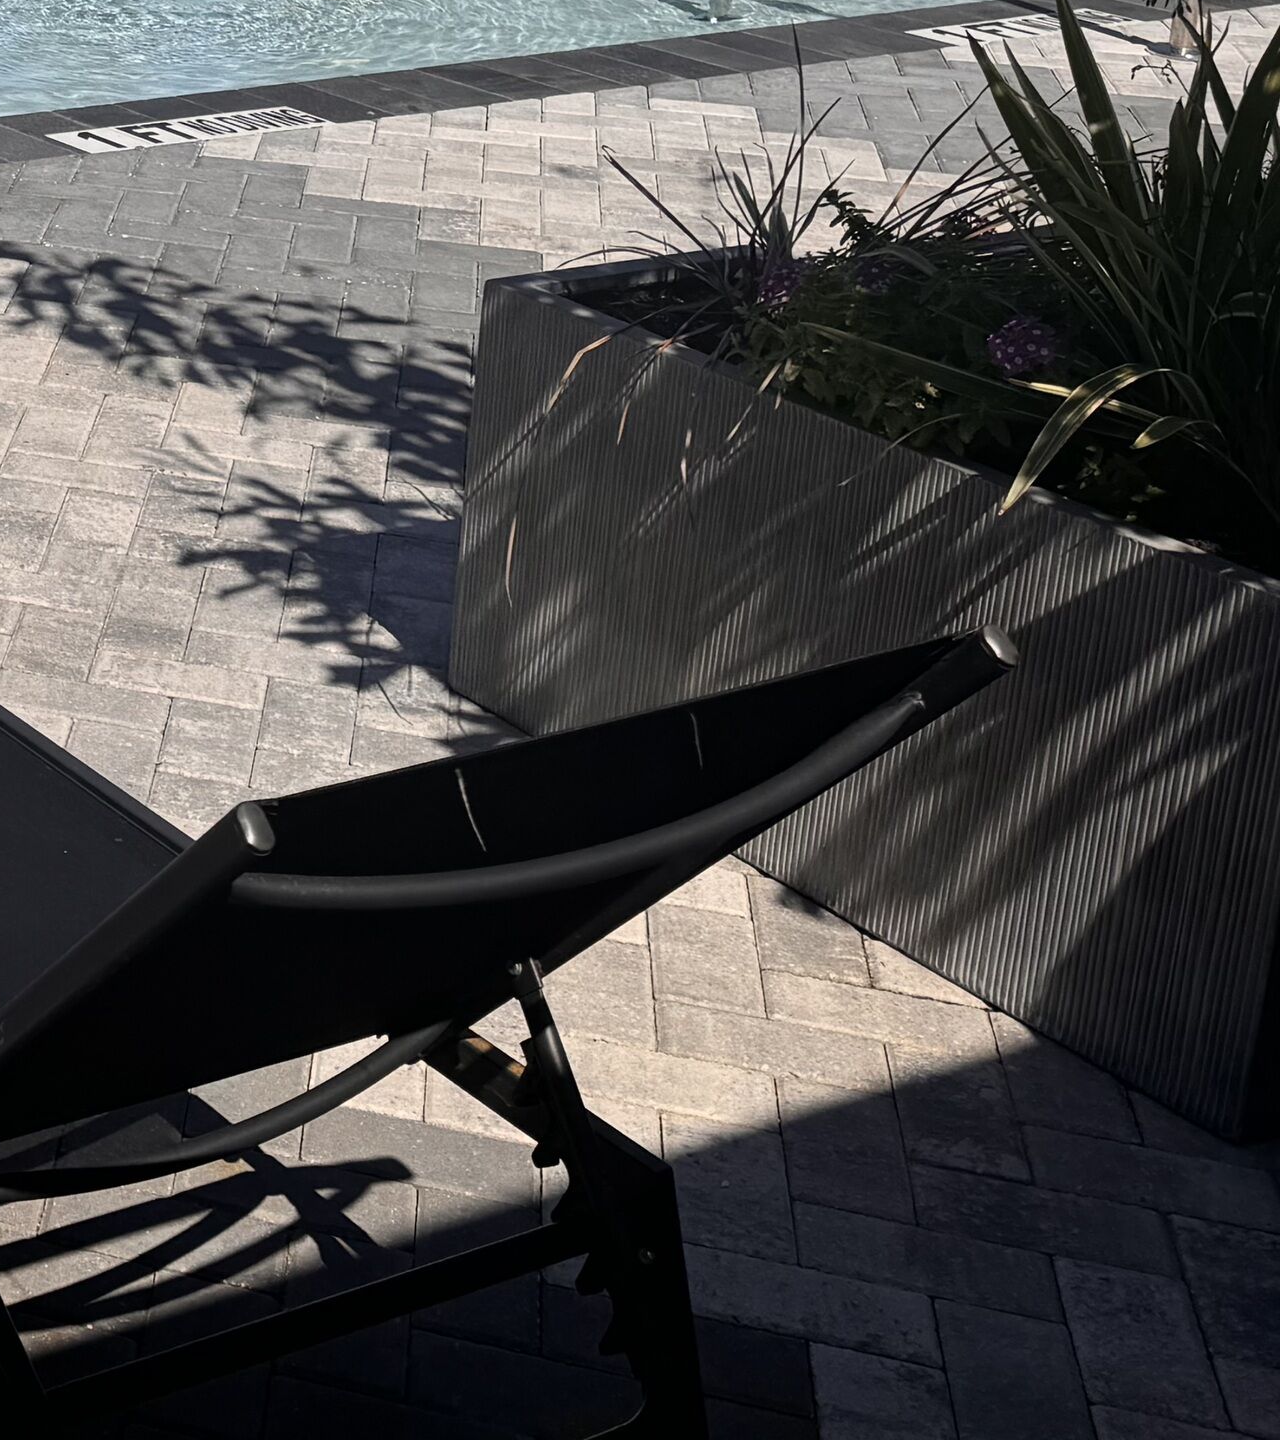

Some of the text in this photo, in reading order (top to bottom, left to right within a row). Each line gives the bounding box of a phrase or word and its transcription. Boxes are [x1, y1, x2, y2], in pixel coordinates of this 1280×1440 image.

[961, 22, 1040, 38] FT
[77, 131, 127, 149] 1
[116, 122, 198, 144] FT
[217, 109, 326, 131] DIVING
